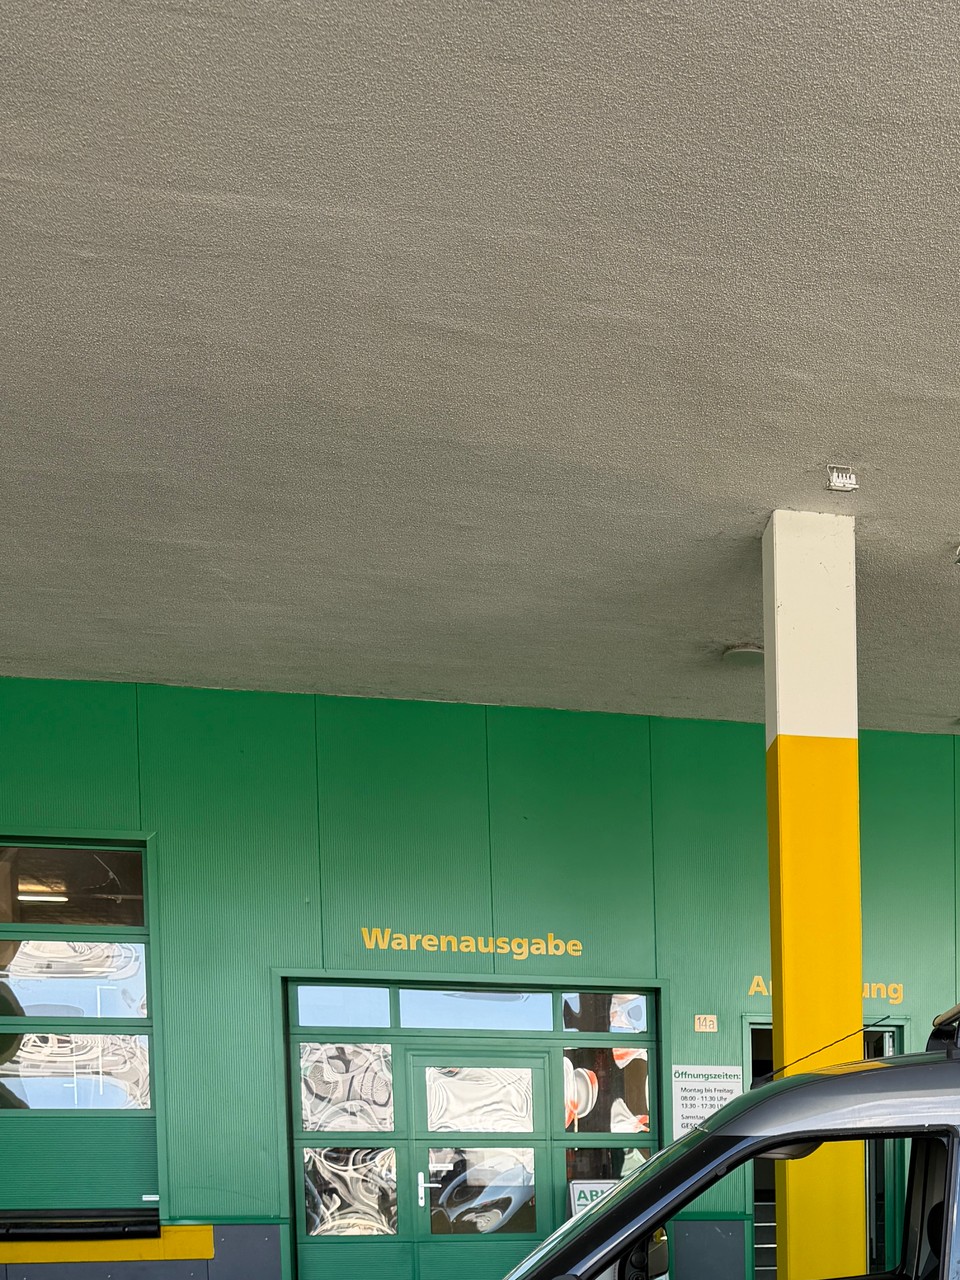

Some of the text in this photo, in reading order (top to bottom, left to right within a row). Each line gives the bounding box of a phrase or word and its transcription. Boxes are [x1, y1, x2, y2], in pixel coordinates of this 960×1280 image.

[361, 927, 583, 960] Warenausgabe
[696, 1016, 715, 1030] 14a
[673, 1069, 741, 1081] Öffnungszeiten:
